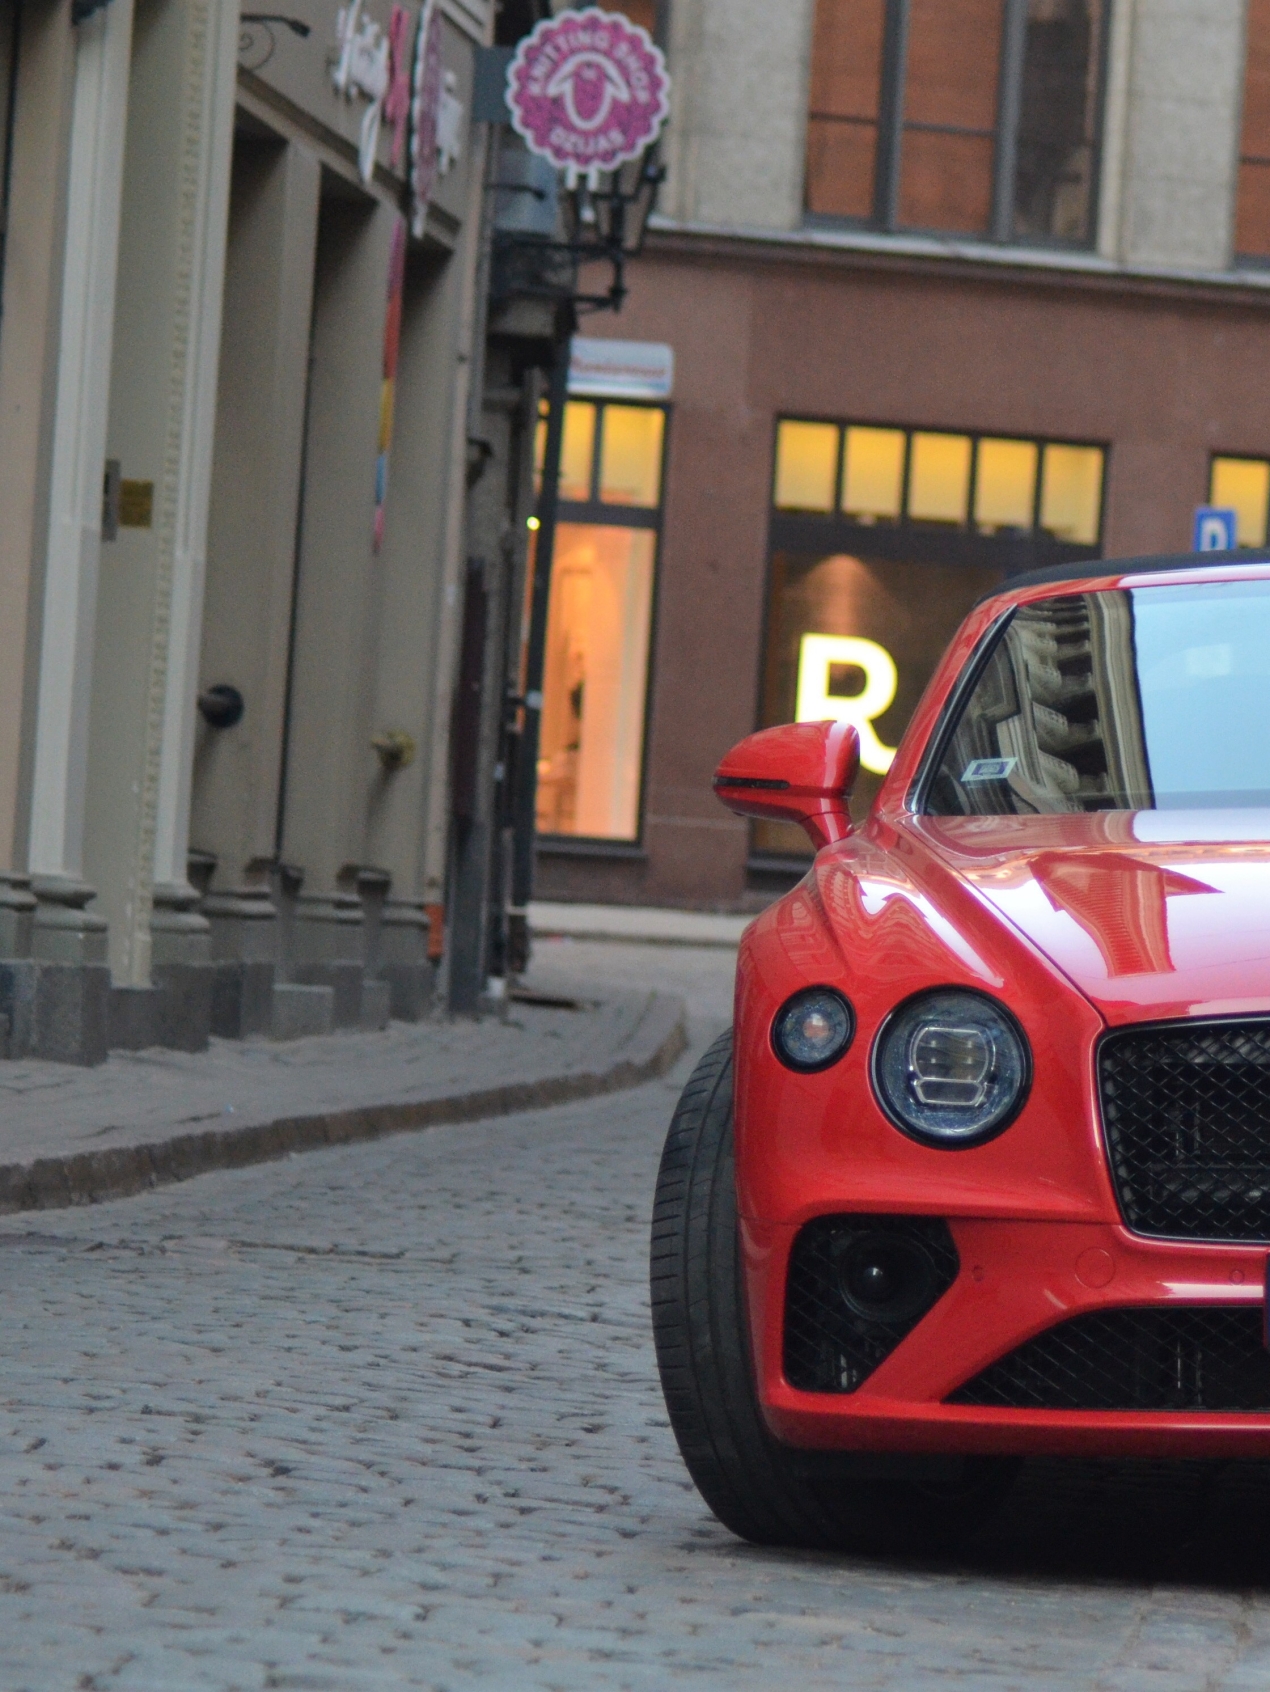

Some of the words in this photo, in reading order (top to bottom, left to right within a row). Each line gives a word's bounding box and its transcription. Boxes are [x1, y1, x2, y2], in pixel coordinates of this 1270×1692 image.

[527, 30, 610, 95] KNITTING
[613, 41, 650, 104] SHOP
[795, 632, 899, 776] R
